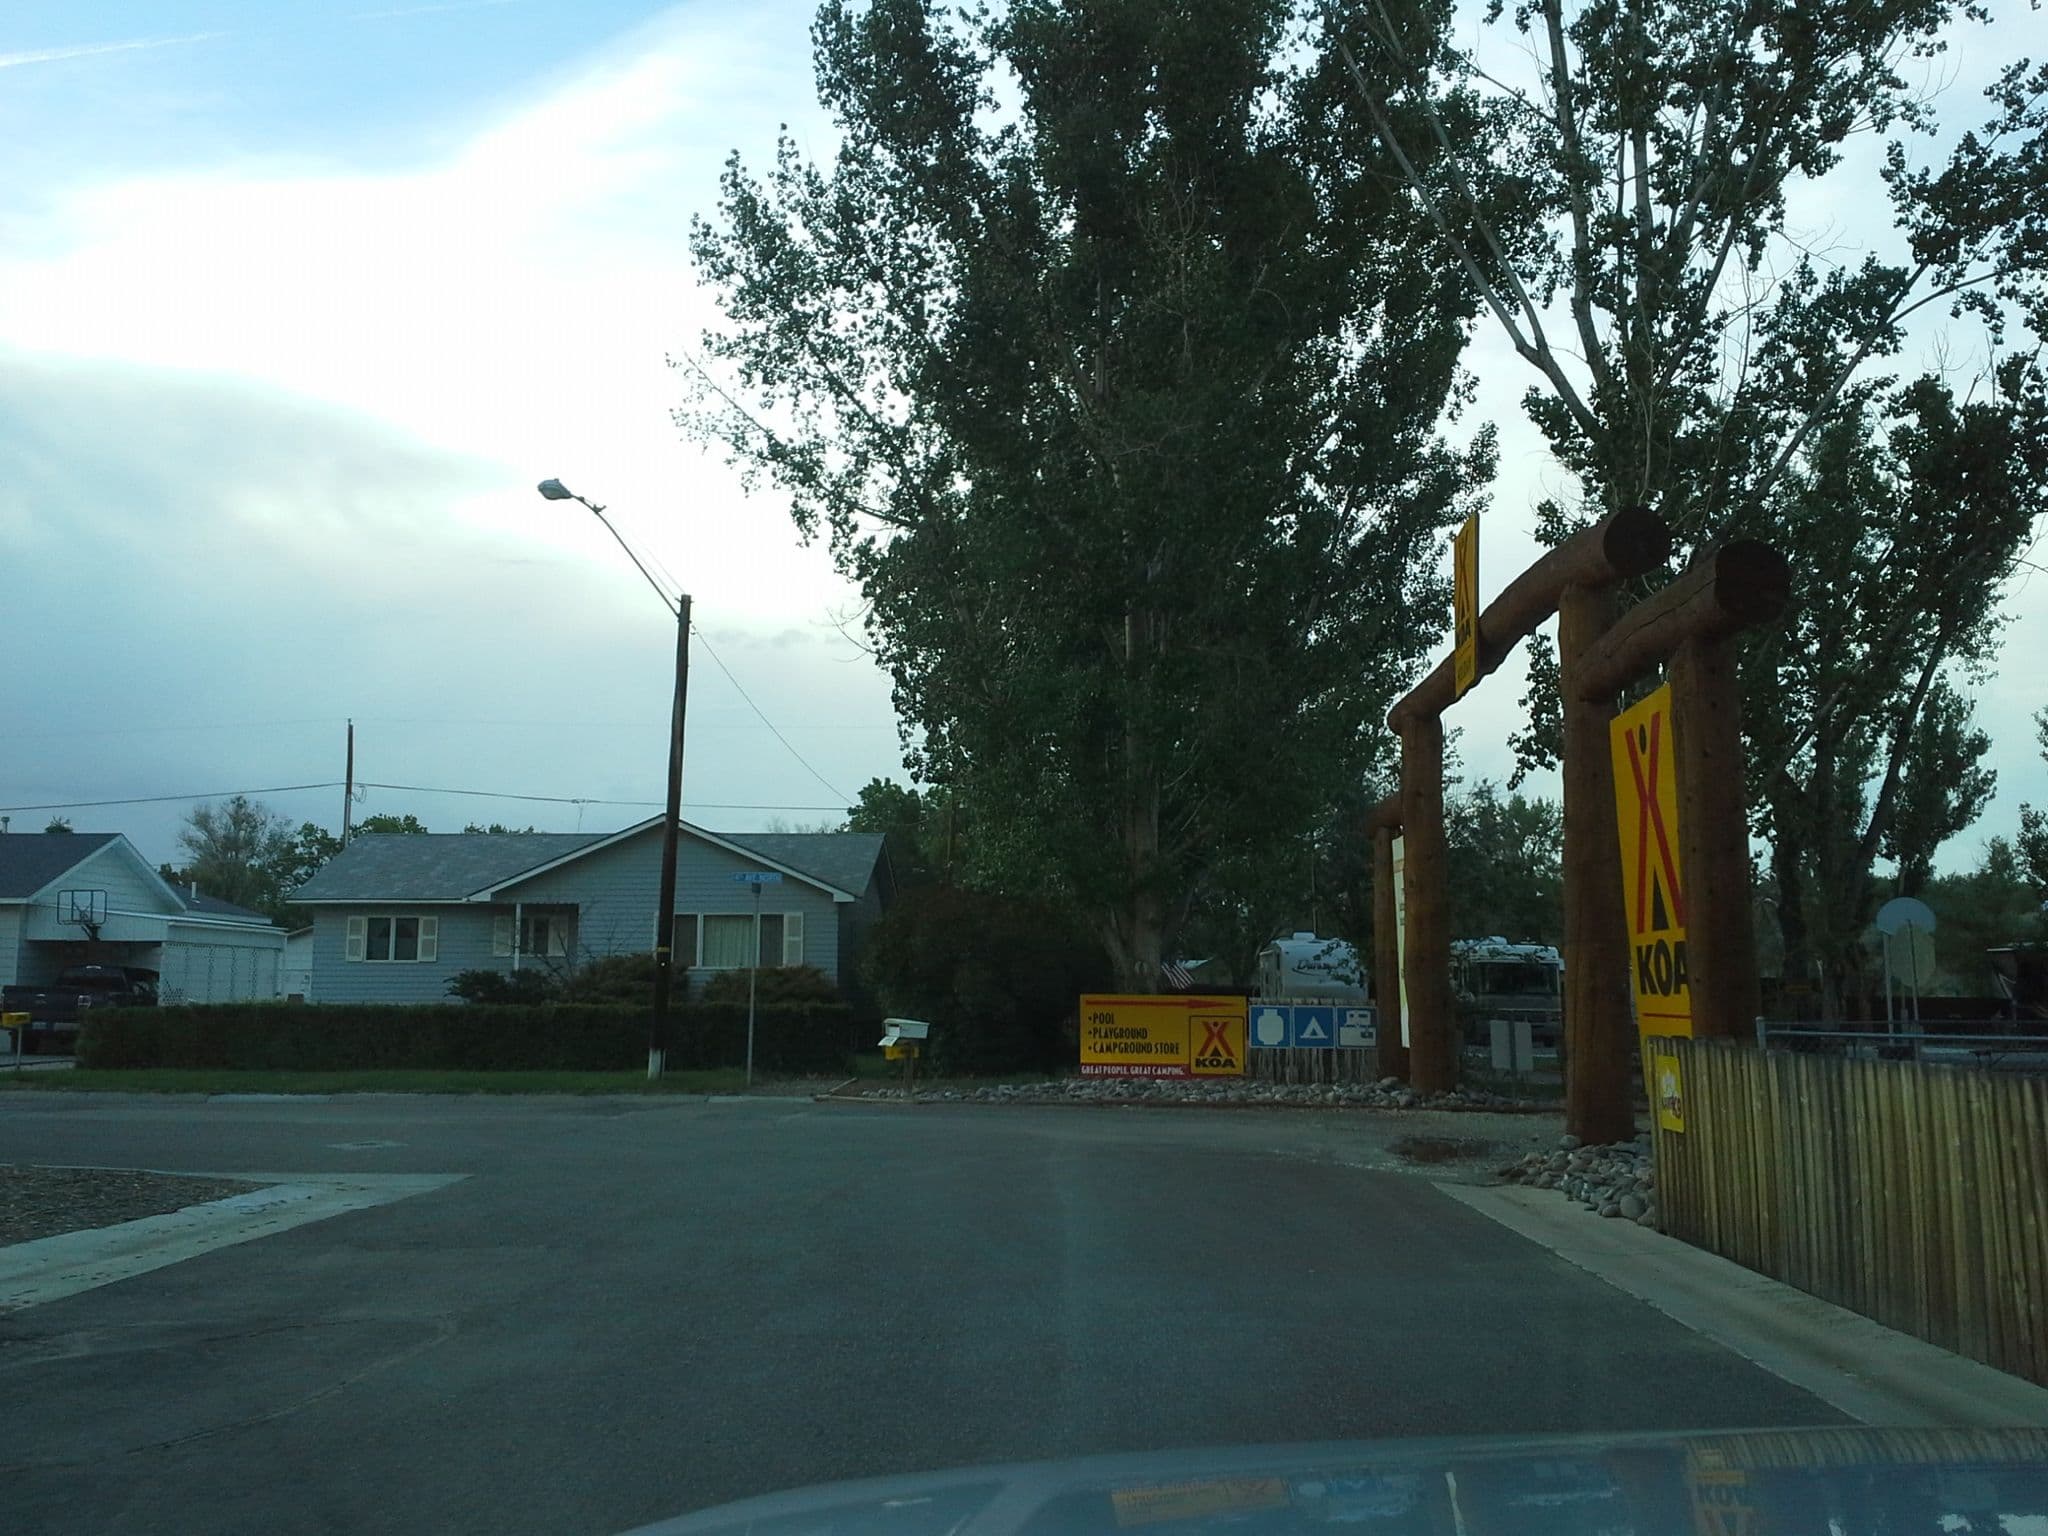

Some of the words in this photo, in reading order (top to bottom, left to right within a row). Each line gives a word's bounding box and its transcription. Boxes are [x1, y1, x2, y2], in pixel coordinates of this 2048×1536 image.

[1637, 939, 1688, 997] KOA
[1093, 1012, 1114, 1025] POOL
[1093, 1028, 1148, 1039] PLAYGROUND
[1093, 1041, 1152, 1054] CAMPGROUND
[1155, 1043, 1179, 1055] STORE
[1195, 1058, 1237, 1068] KOA
[1081, 1065, 1102, 1074] GREAT
[1130, 1066, 1151, 1075] GREAT
